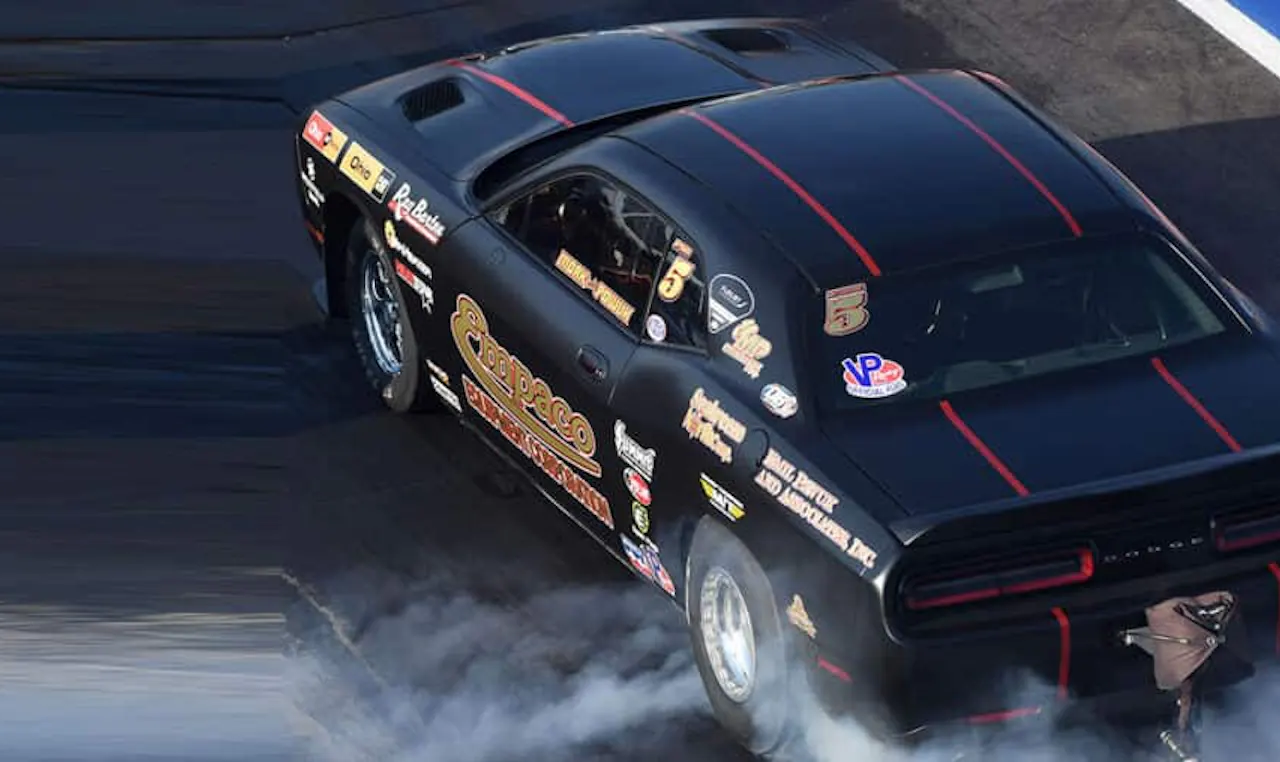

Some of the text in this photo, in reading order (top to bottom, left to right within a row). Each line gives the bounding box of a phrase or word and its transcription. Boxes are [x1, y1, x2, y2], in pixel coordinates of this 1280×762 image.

[658, 256, 695, 302] 5
[451, 293, 602, 478] Empaco
[842, 352, 884, 388] VP
